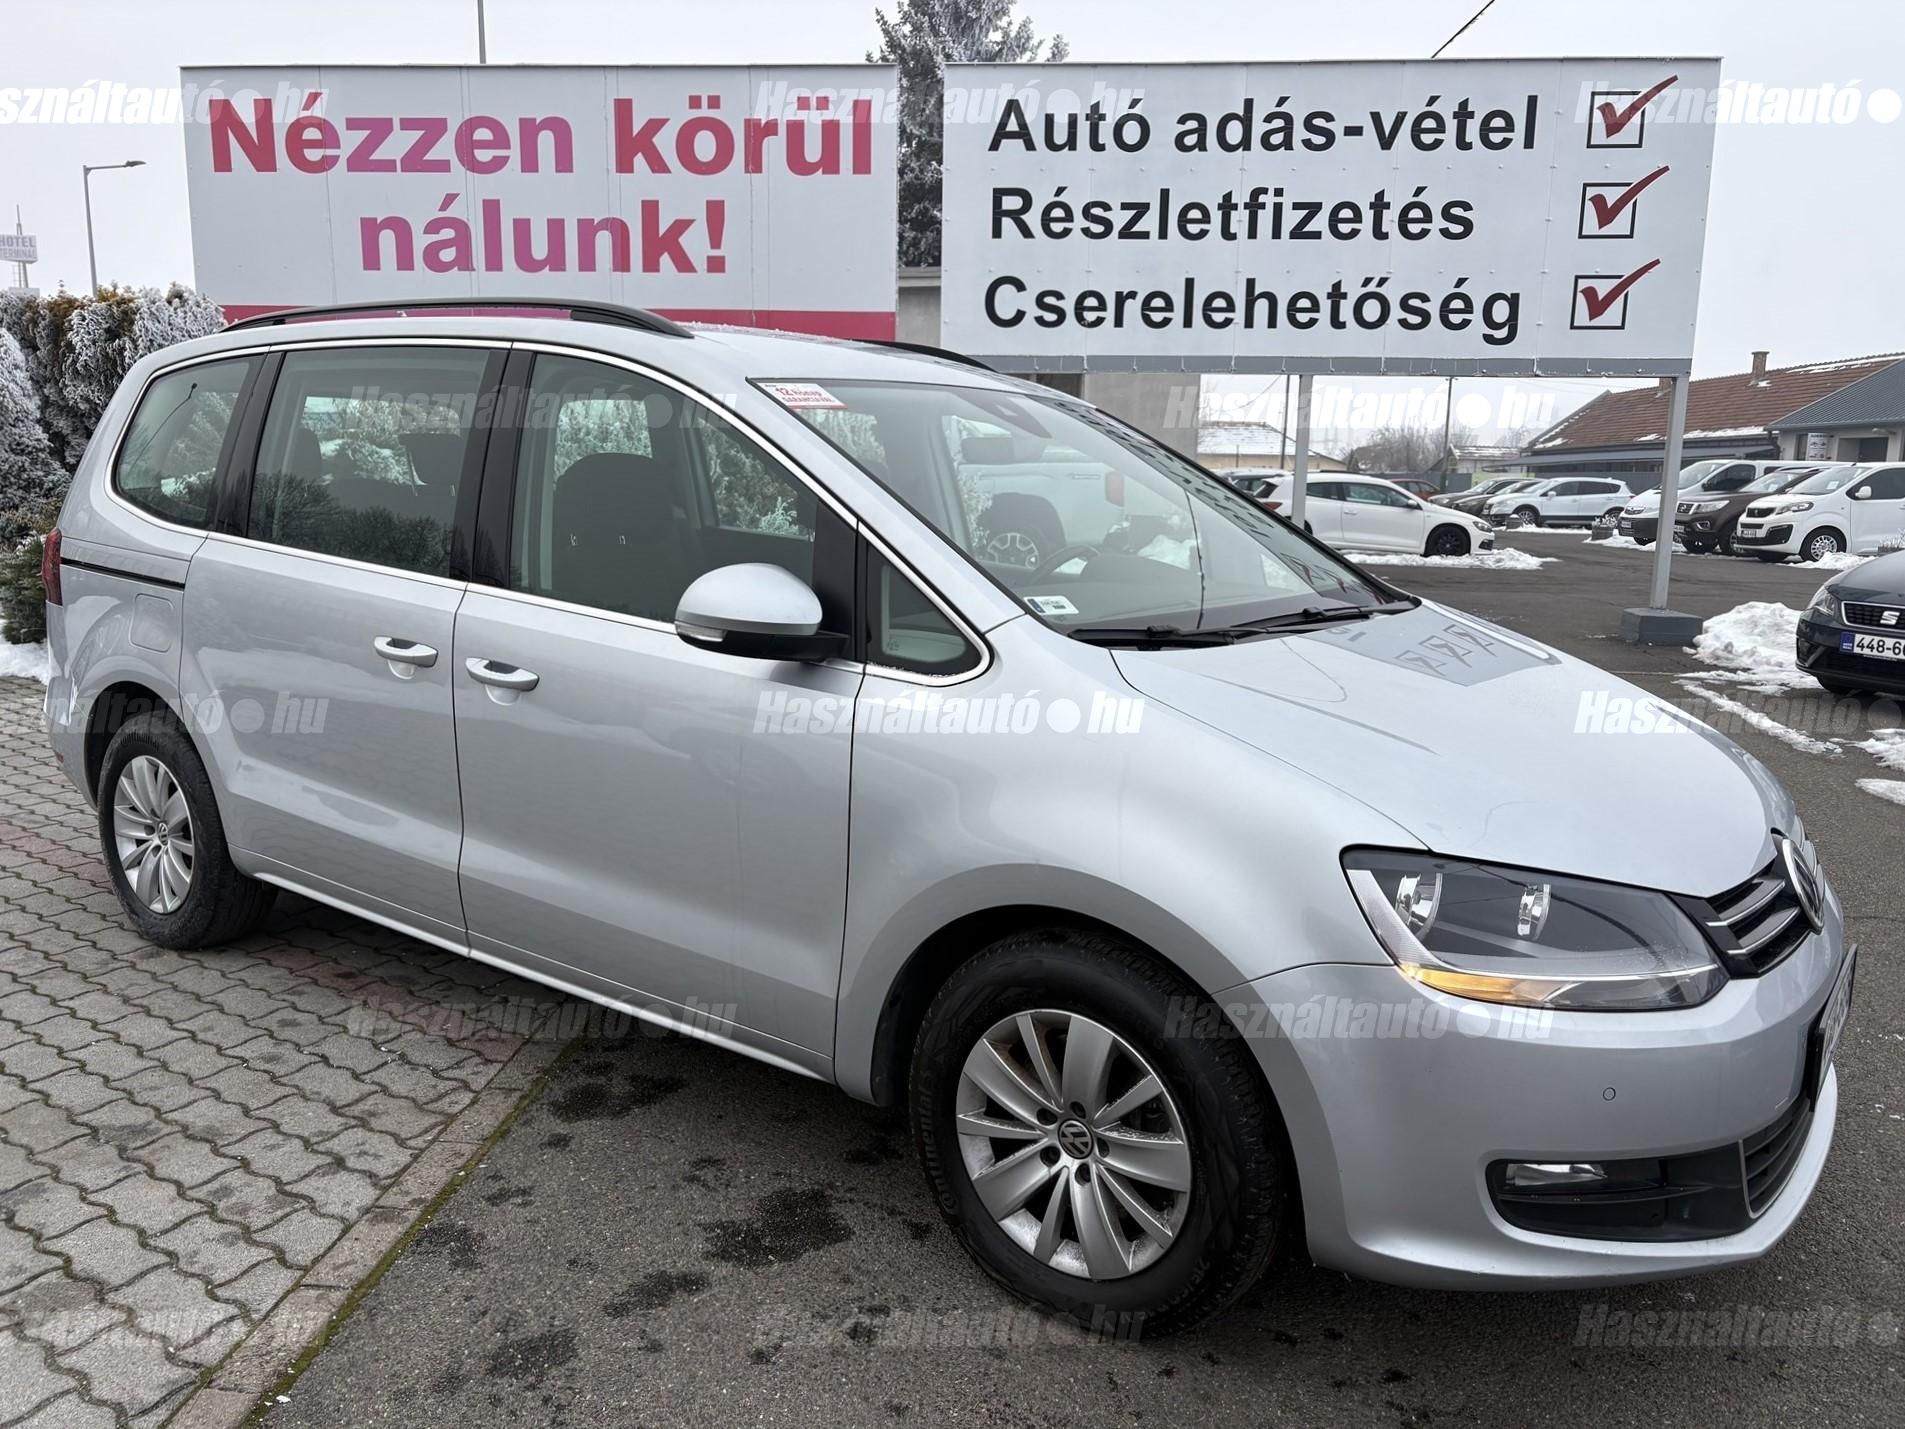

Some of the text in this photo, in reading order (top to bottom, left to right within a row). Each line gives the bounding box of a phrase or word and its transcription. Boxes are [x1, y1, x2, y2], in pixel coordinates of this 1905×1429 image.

[210, 92, 872, 176] Nézzen körül
[988, 94, 1538, 153] Autó adás-vétel
[361, 194, 726, 273] nálunk!
[991, 185, 1474, 242] Részletfizetés
[984, 275, 1520, 346] Cserelehetőség
[1856, 637, 1905, 656] 448-6
